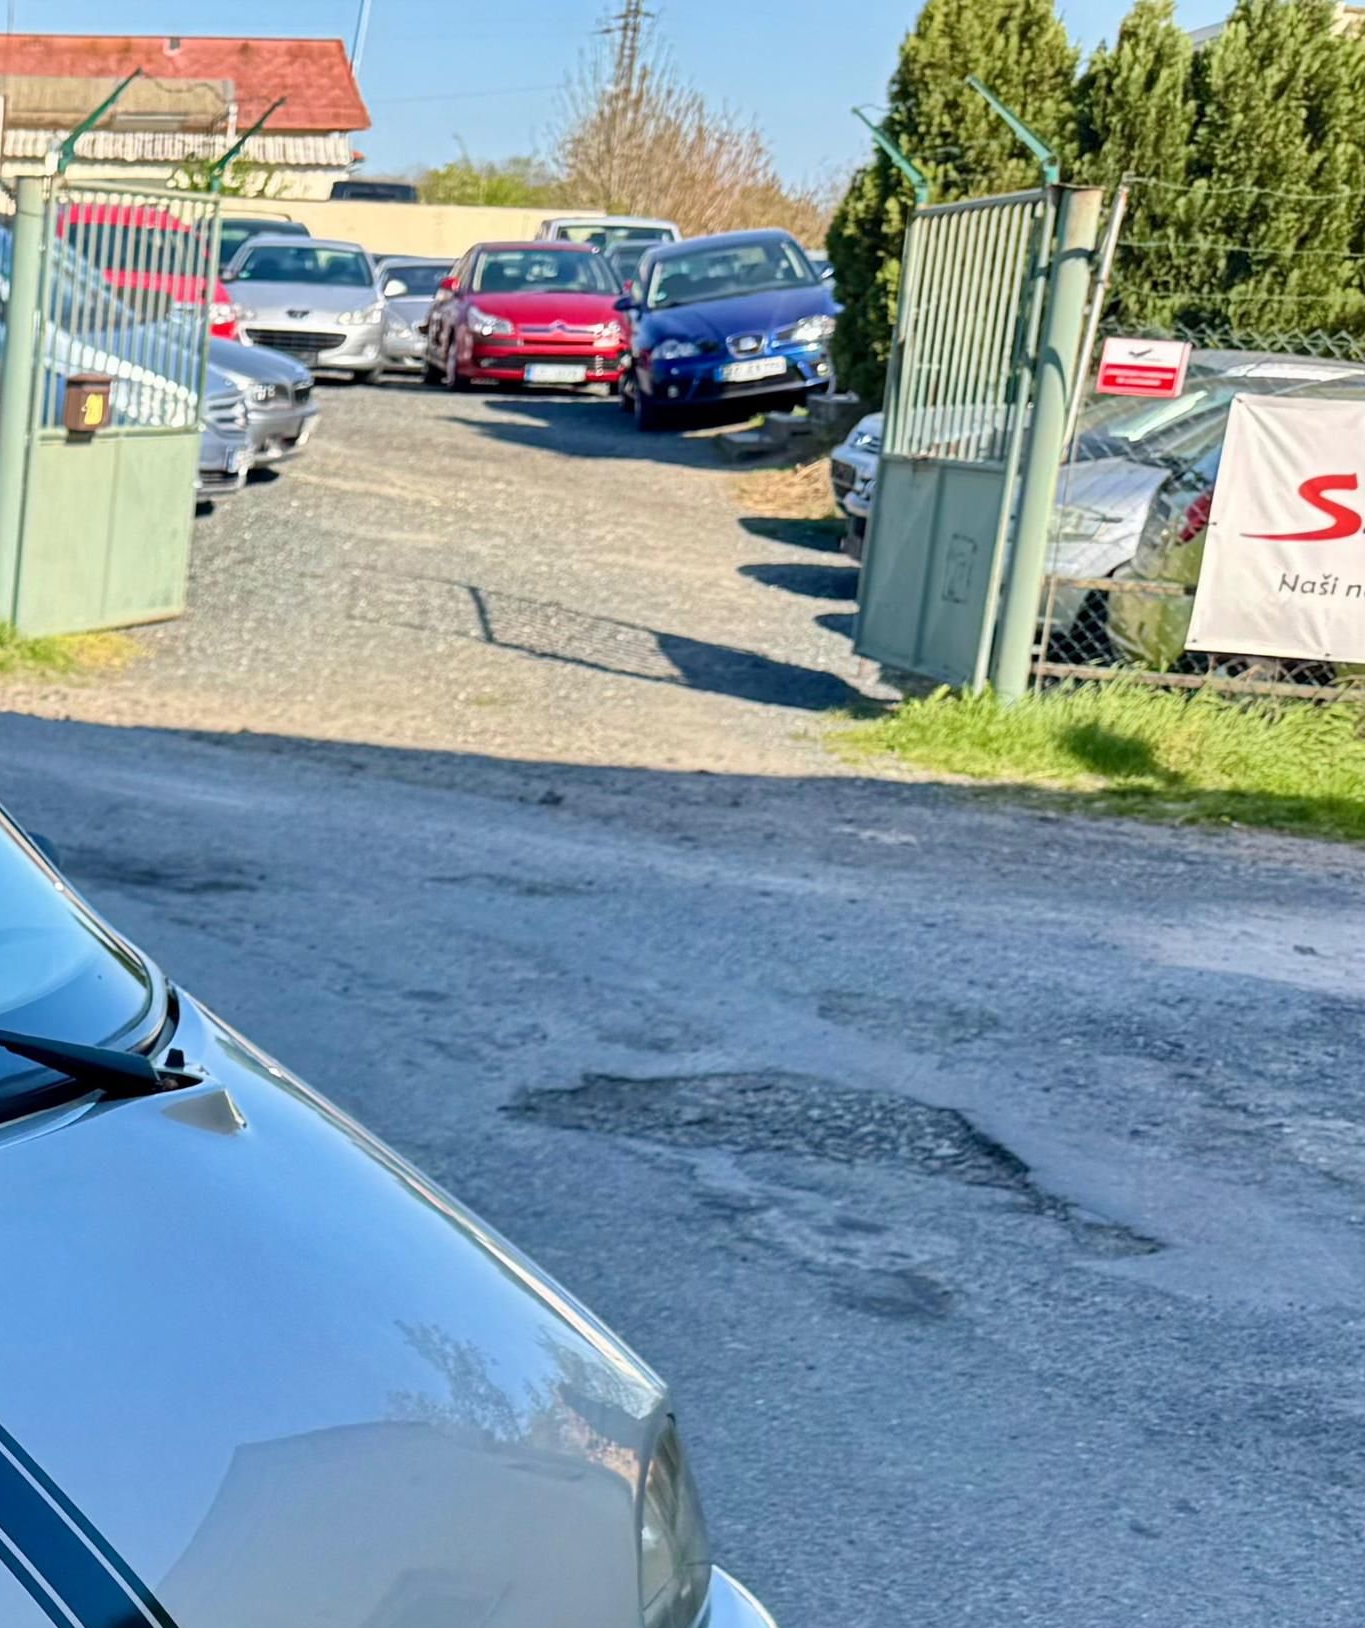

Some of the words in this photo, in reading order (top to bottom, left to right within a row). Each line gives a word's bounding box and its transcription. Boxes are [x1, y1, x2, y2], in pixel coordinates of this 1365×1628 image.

[1239, 473, 1365, 541] S
[1278, 572, 1339, 596] Naši
[1345, 583, 1365, 598] n
